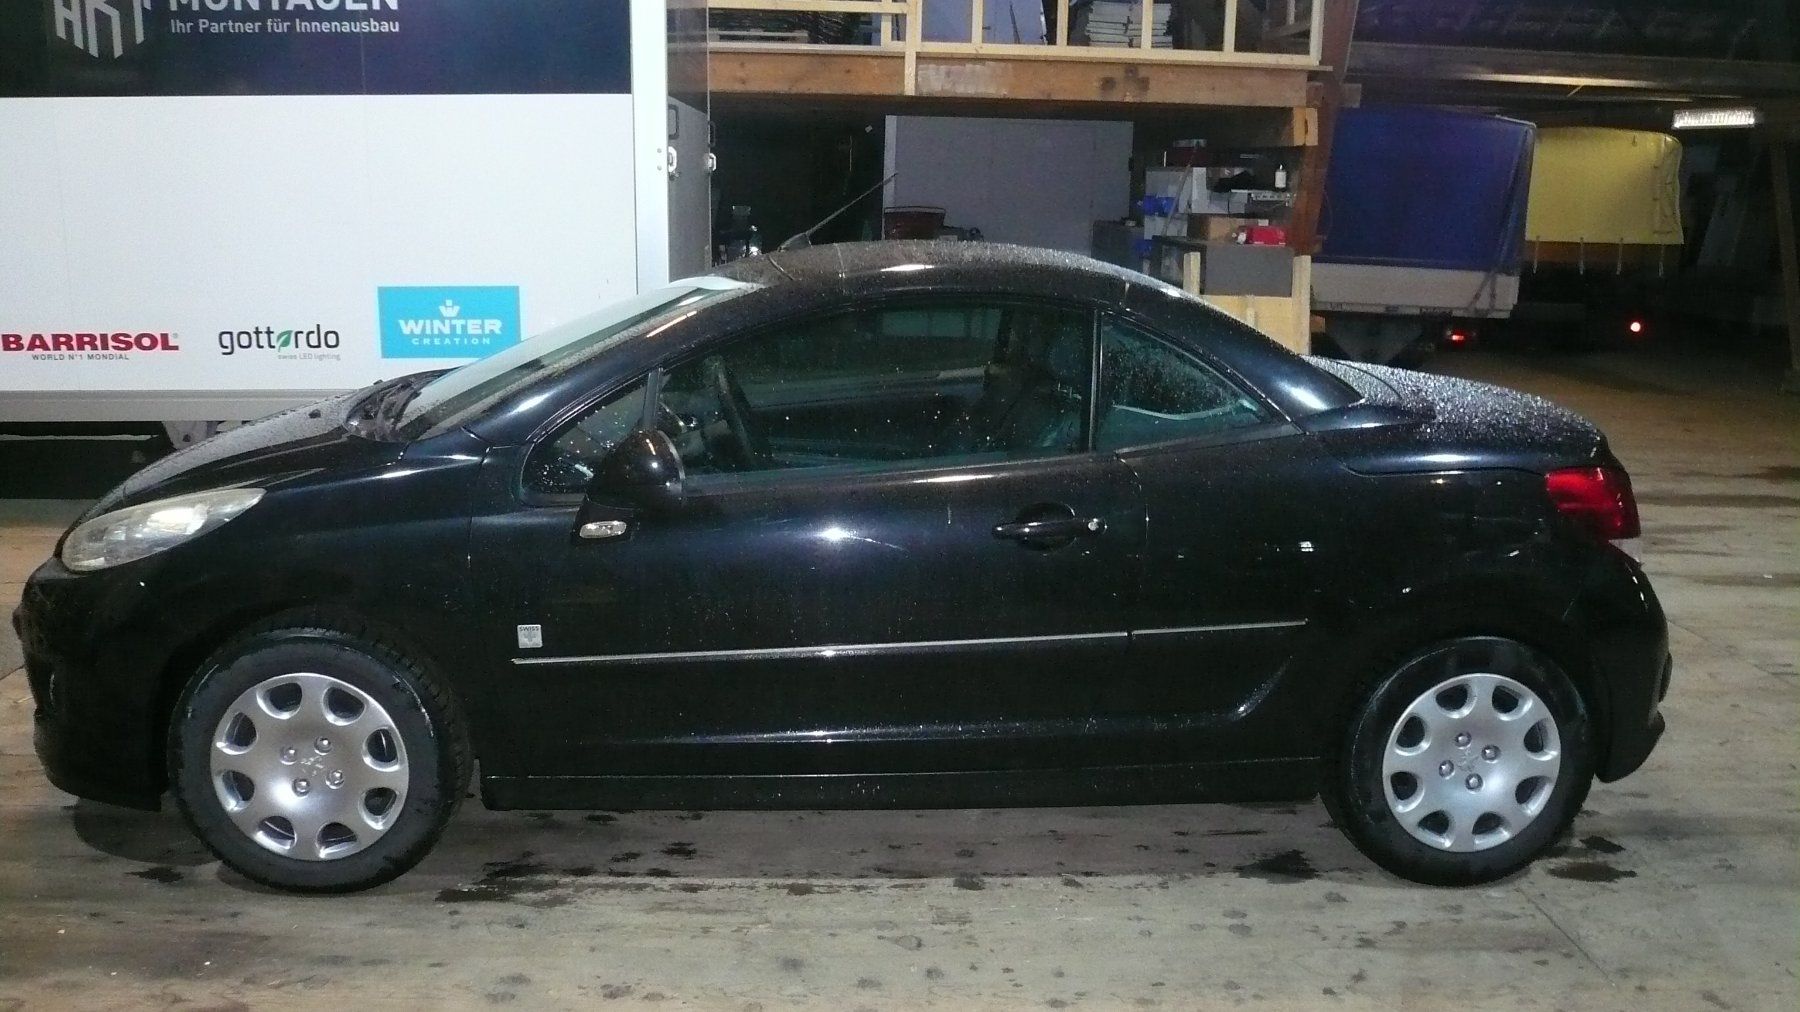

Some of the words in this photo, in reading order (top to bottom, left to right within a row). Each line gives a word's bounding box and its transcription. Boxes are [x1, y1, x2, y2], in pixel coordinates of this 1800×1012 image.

[170, 19, 193, 33] Ihr
[199, 18, 262, 33] Partner
[267, 18, 291, 33] für
[295, 18, 400, 33] Innenausbau
[398, 318, 503, 335] WINTER
[32, 353, 65, 361] WORLD
[87, 353, 130, 361] MONDIAL
[314, 353, 341, 362] lighting
